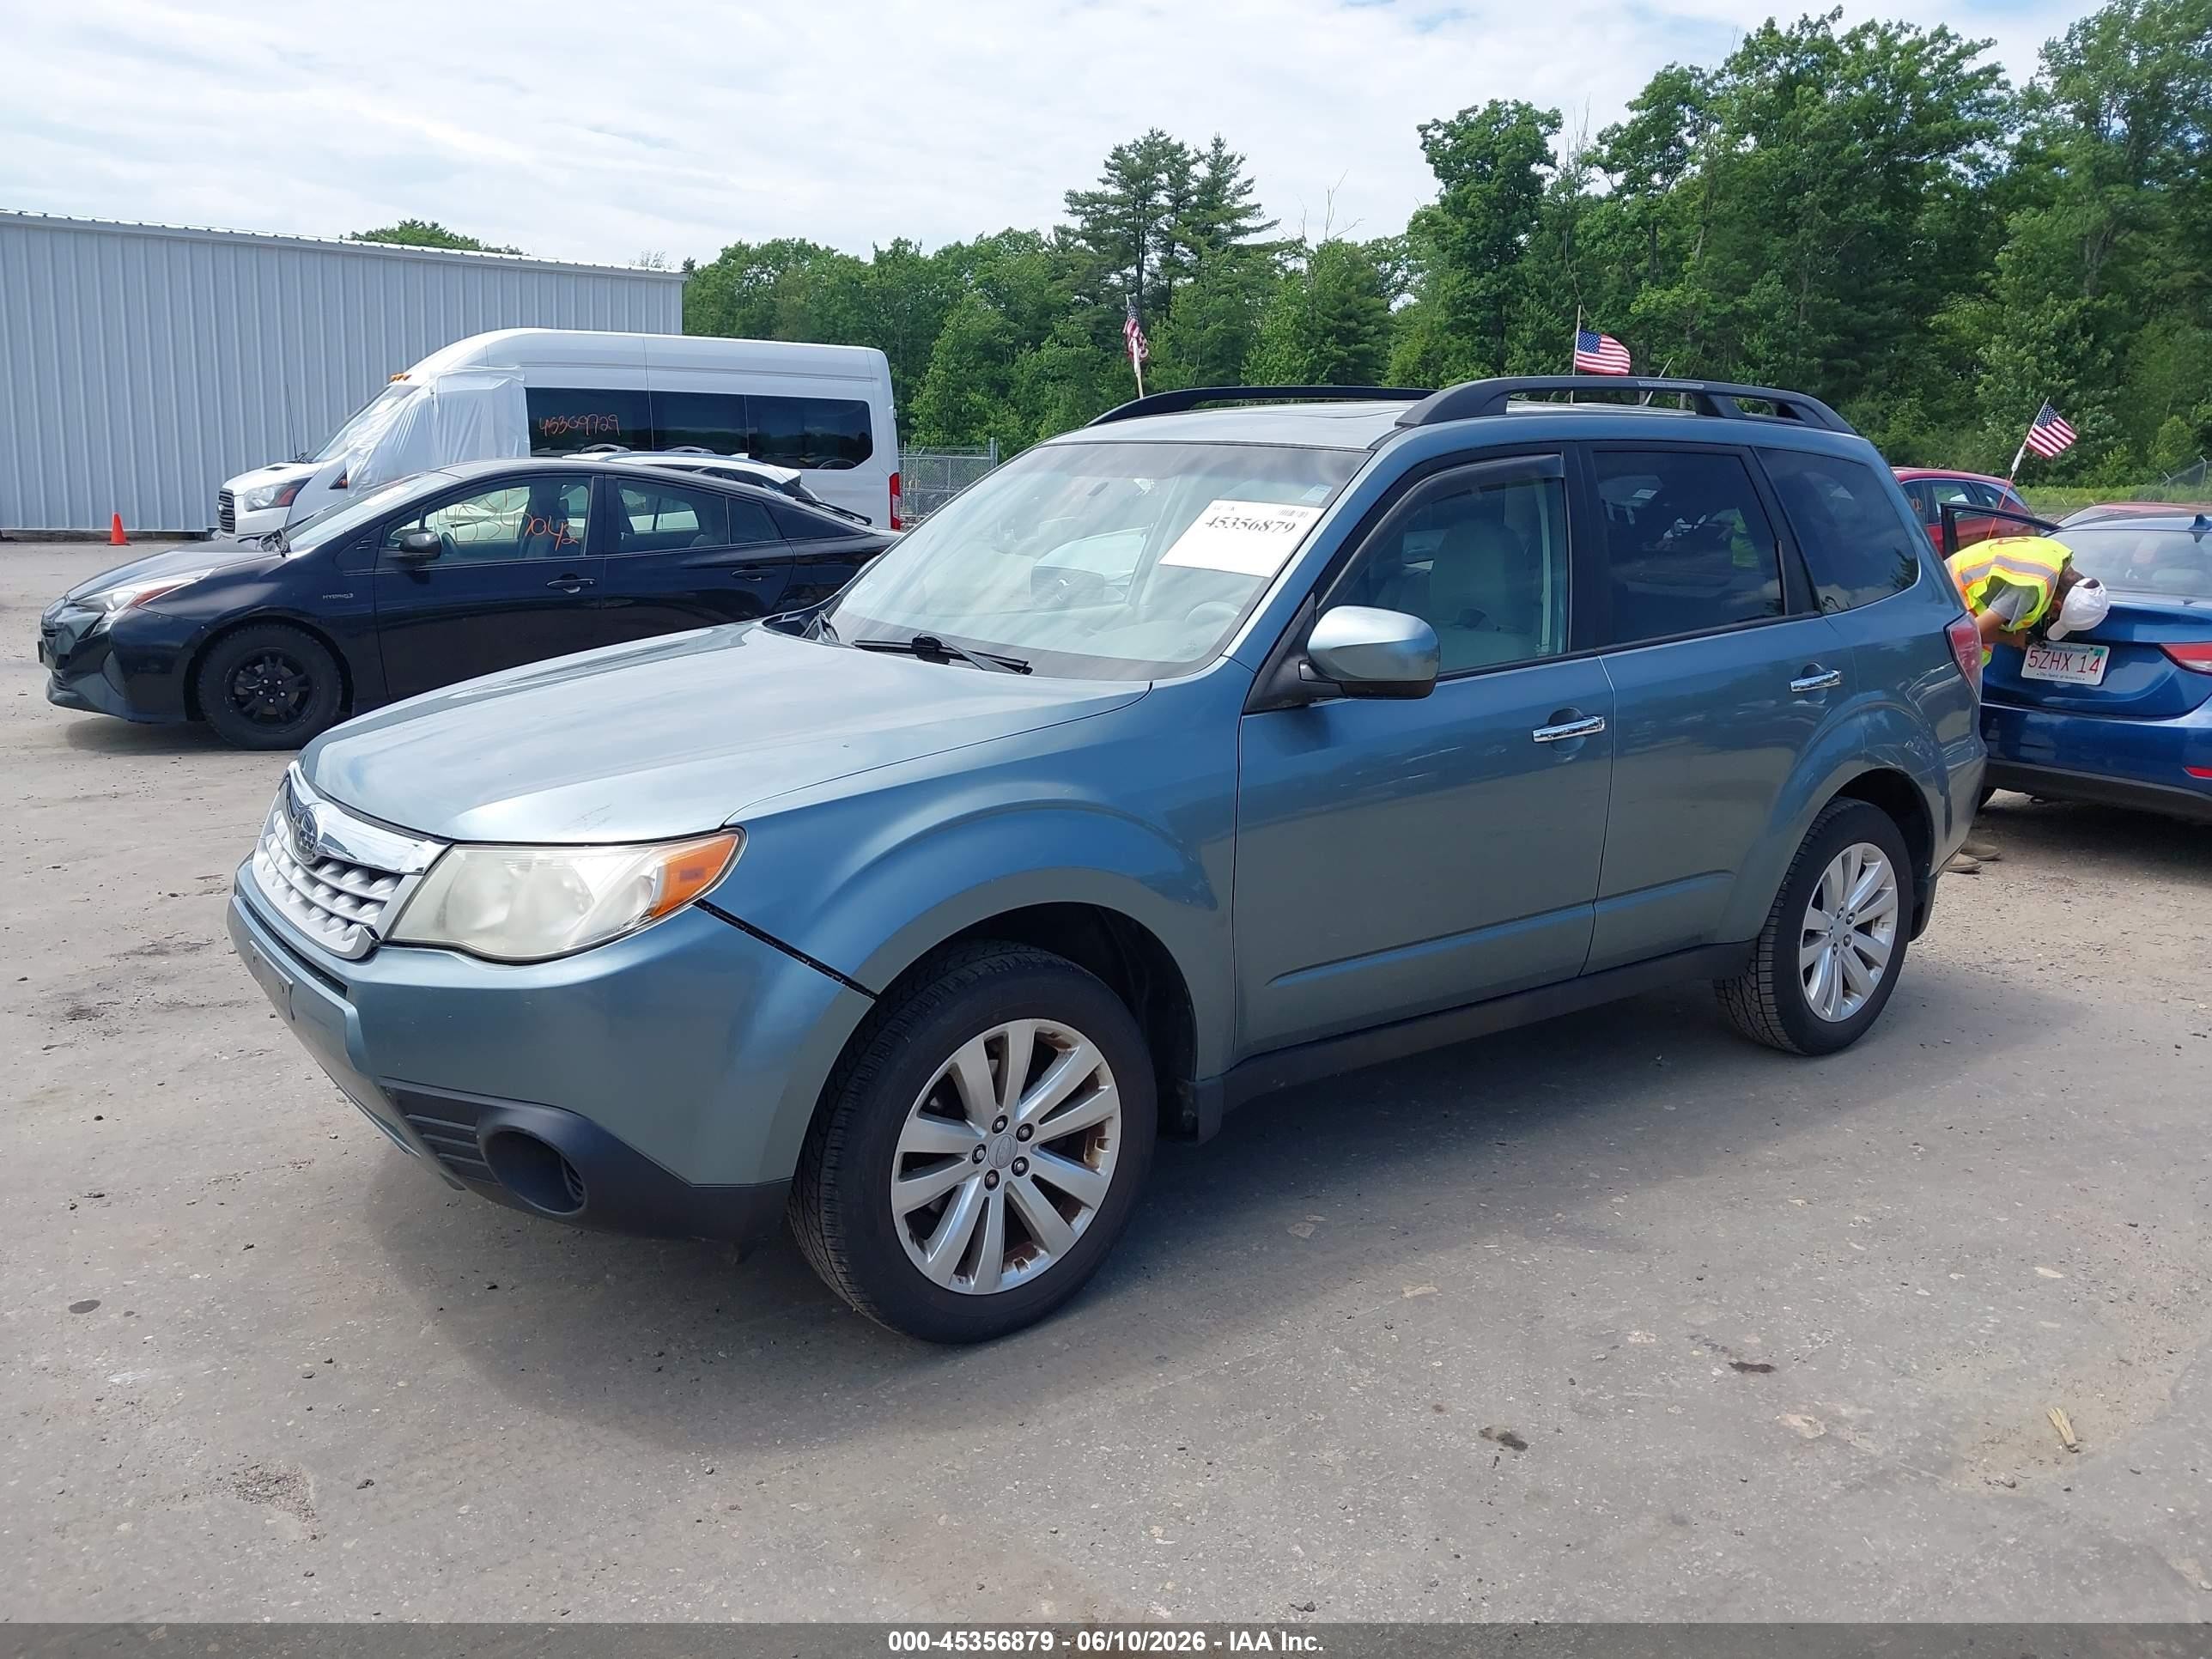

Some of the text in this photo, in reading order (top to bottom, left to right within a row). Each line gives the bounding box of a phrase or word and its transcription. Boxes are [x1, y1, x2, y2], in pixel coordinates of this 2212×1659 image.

[538, 413, 621, 437] 45309729
[1206, 515, 1297, 534] 45356879
[2027, 649, 2101, 675] 5ZHX 14
